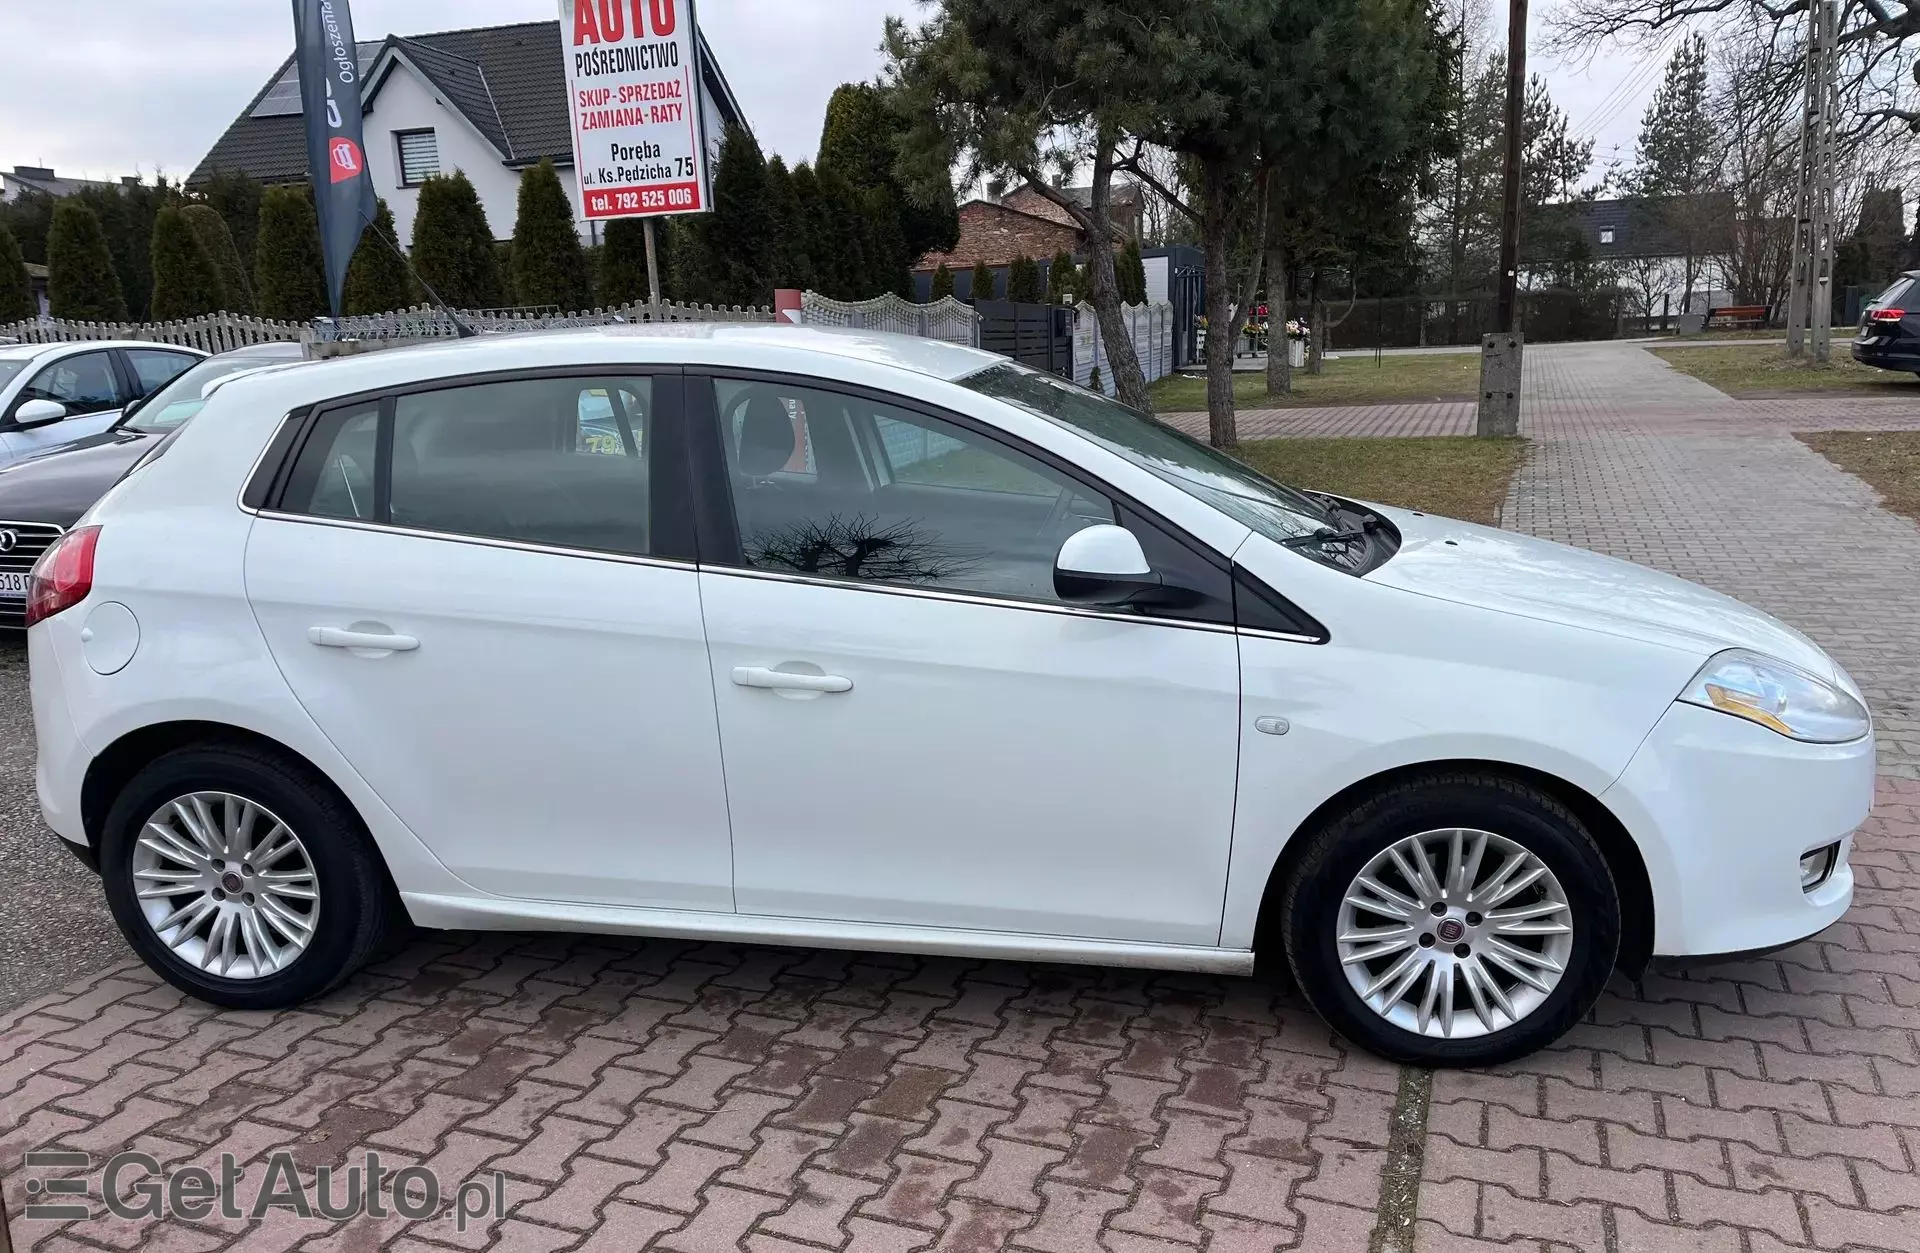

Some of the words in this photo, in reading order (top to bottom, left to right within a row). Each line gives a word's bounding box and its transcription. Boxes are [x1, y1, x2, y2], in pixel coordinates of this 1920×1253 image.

[573, 0, 676, 46] AUTO
[575, 41, 679, 77] POŚREDNICTWO
[611, 140, 661, 162] Poręba
[583, 172, 596, 185] ul.
[674, 157, 694, 178] 75
[591, 193, 613, 211] tel.
[615, 192, 638, 209] 792
[641, 190, 665, 207] 525
[668, 188, 692, 205] 006
